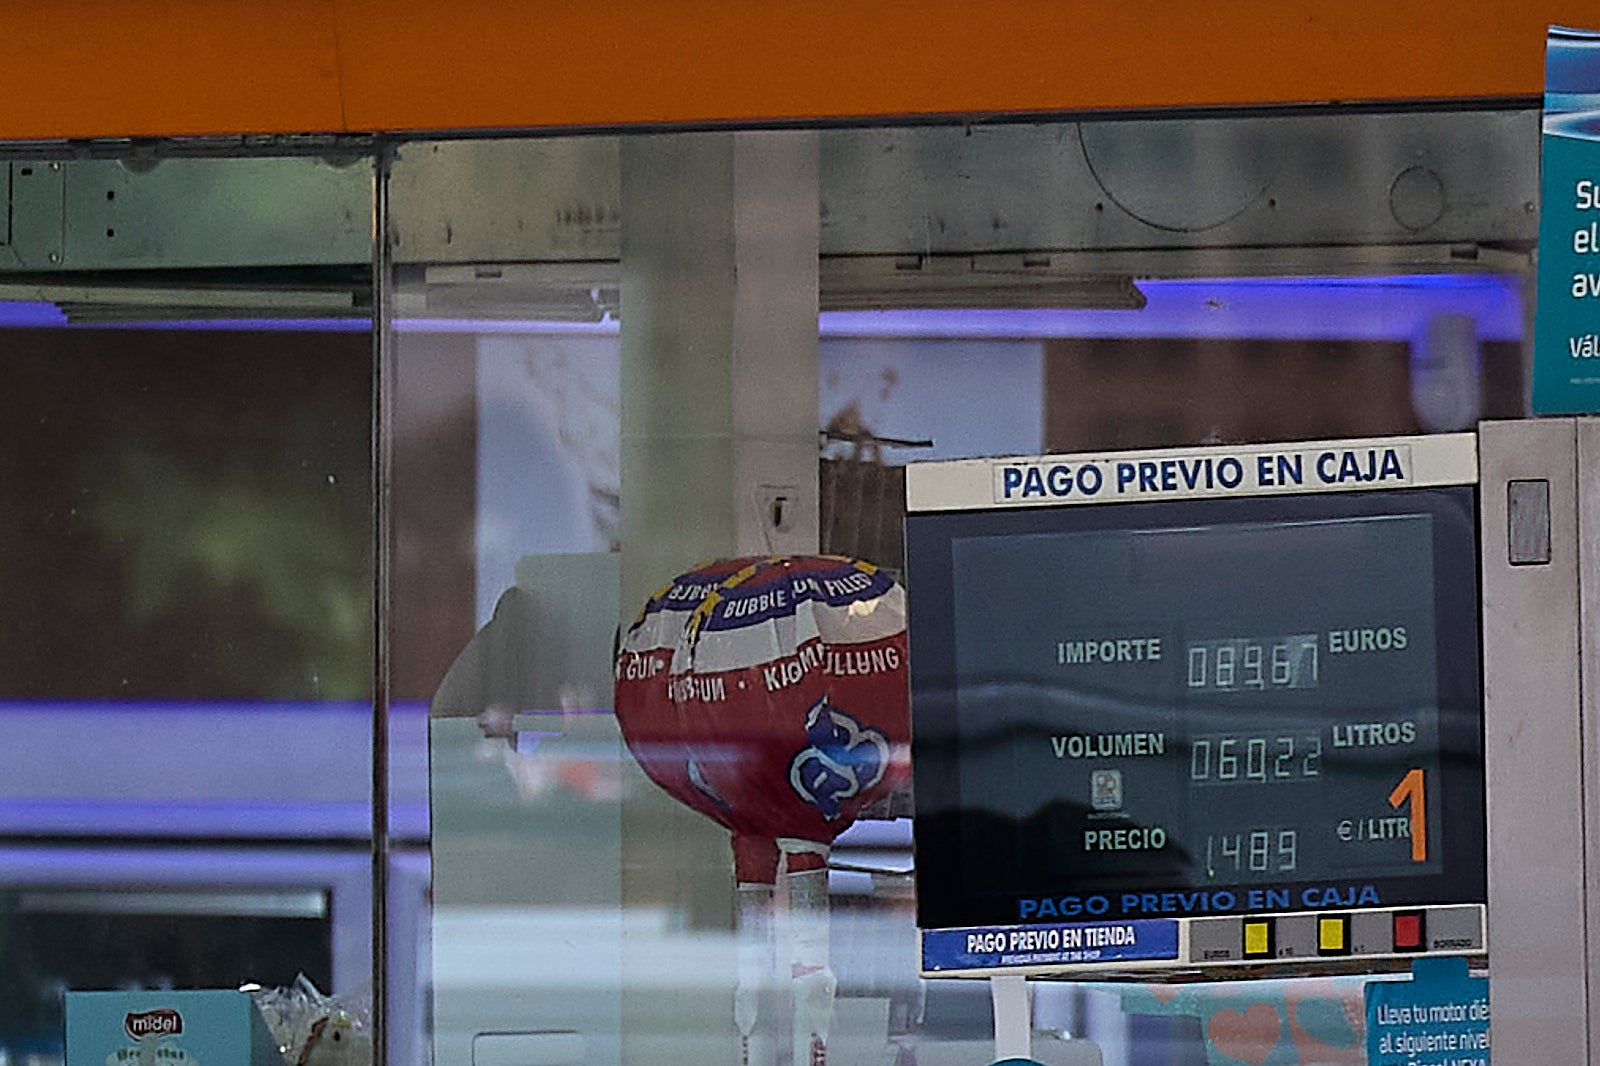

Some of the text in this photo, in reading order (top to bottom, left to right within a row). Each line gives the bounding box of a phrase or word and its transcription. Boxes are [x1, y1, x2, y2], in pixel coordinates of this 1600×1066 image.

[1573, 221, 1599, 253] el
[1003, 449, 1405, 499] PAGO PREVIO EN CAJA
[1057, 638, 1162, 665] IMPORTE
[1329, 627, 1407, 653] EUROS
[1051, 733, 1165, 758] VOLUMEN
[1332, 720, 1416, 748] LITROS
[1387, 768, 1426, 863] 1
[1084, 828, 1166, 851] PRECIO
[1018, 885, 1381, 919] PAGO PREVIO EN CAJA
[966, 926, 1135, 953] PAGO PREVIO EN TIENDA
[132, 1015, 177, 1032] midel
[1377, 1003, 1412, 1025] Lleva
[1413, 1004, 1427, 1024] tu
[1429, 1003, 1467, 1022] motor
[1379, 1032, 1394, 1054] al
[1395, 1030, 1457, 1058] siguiente
